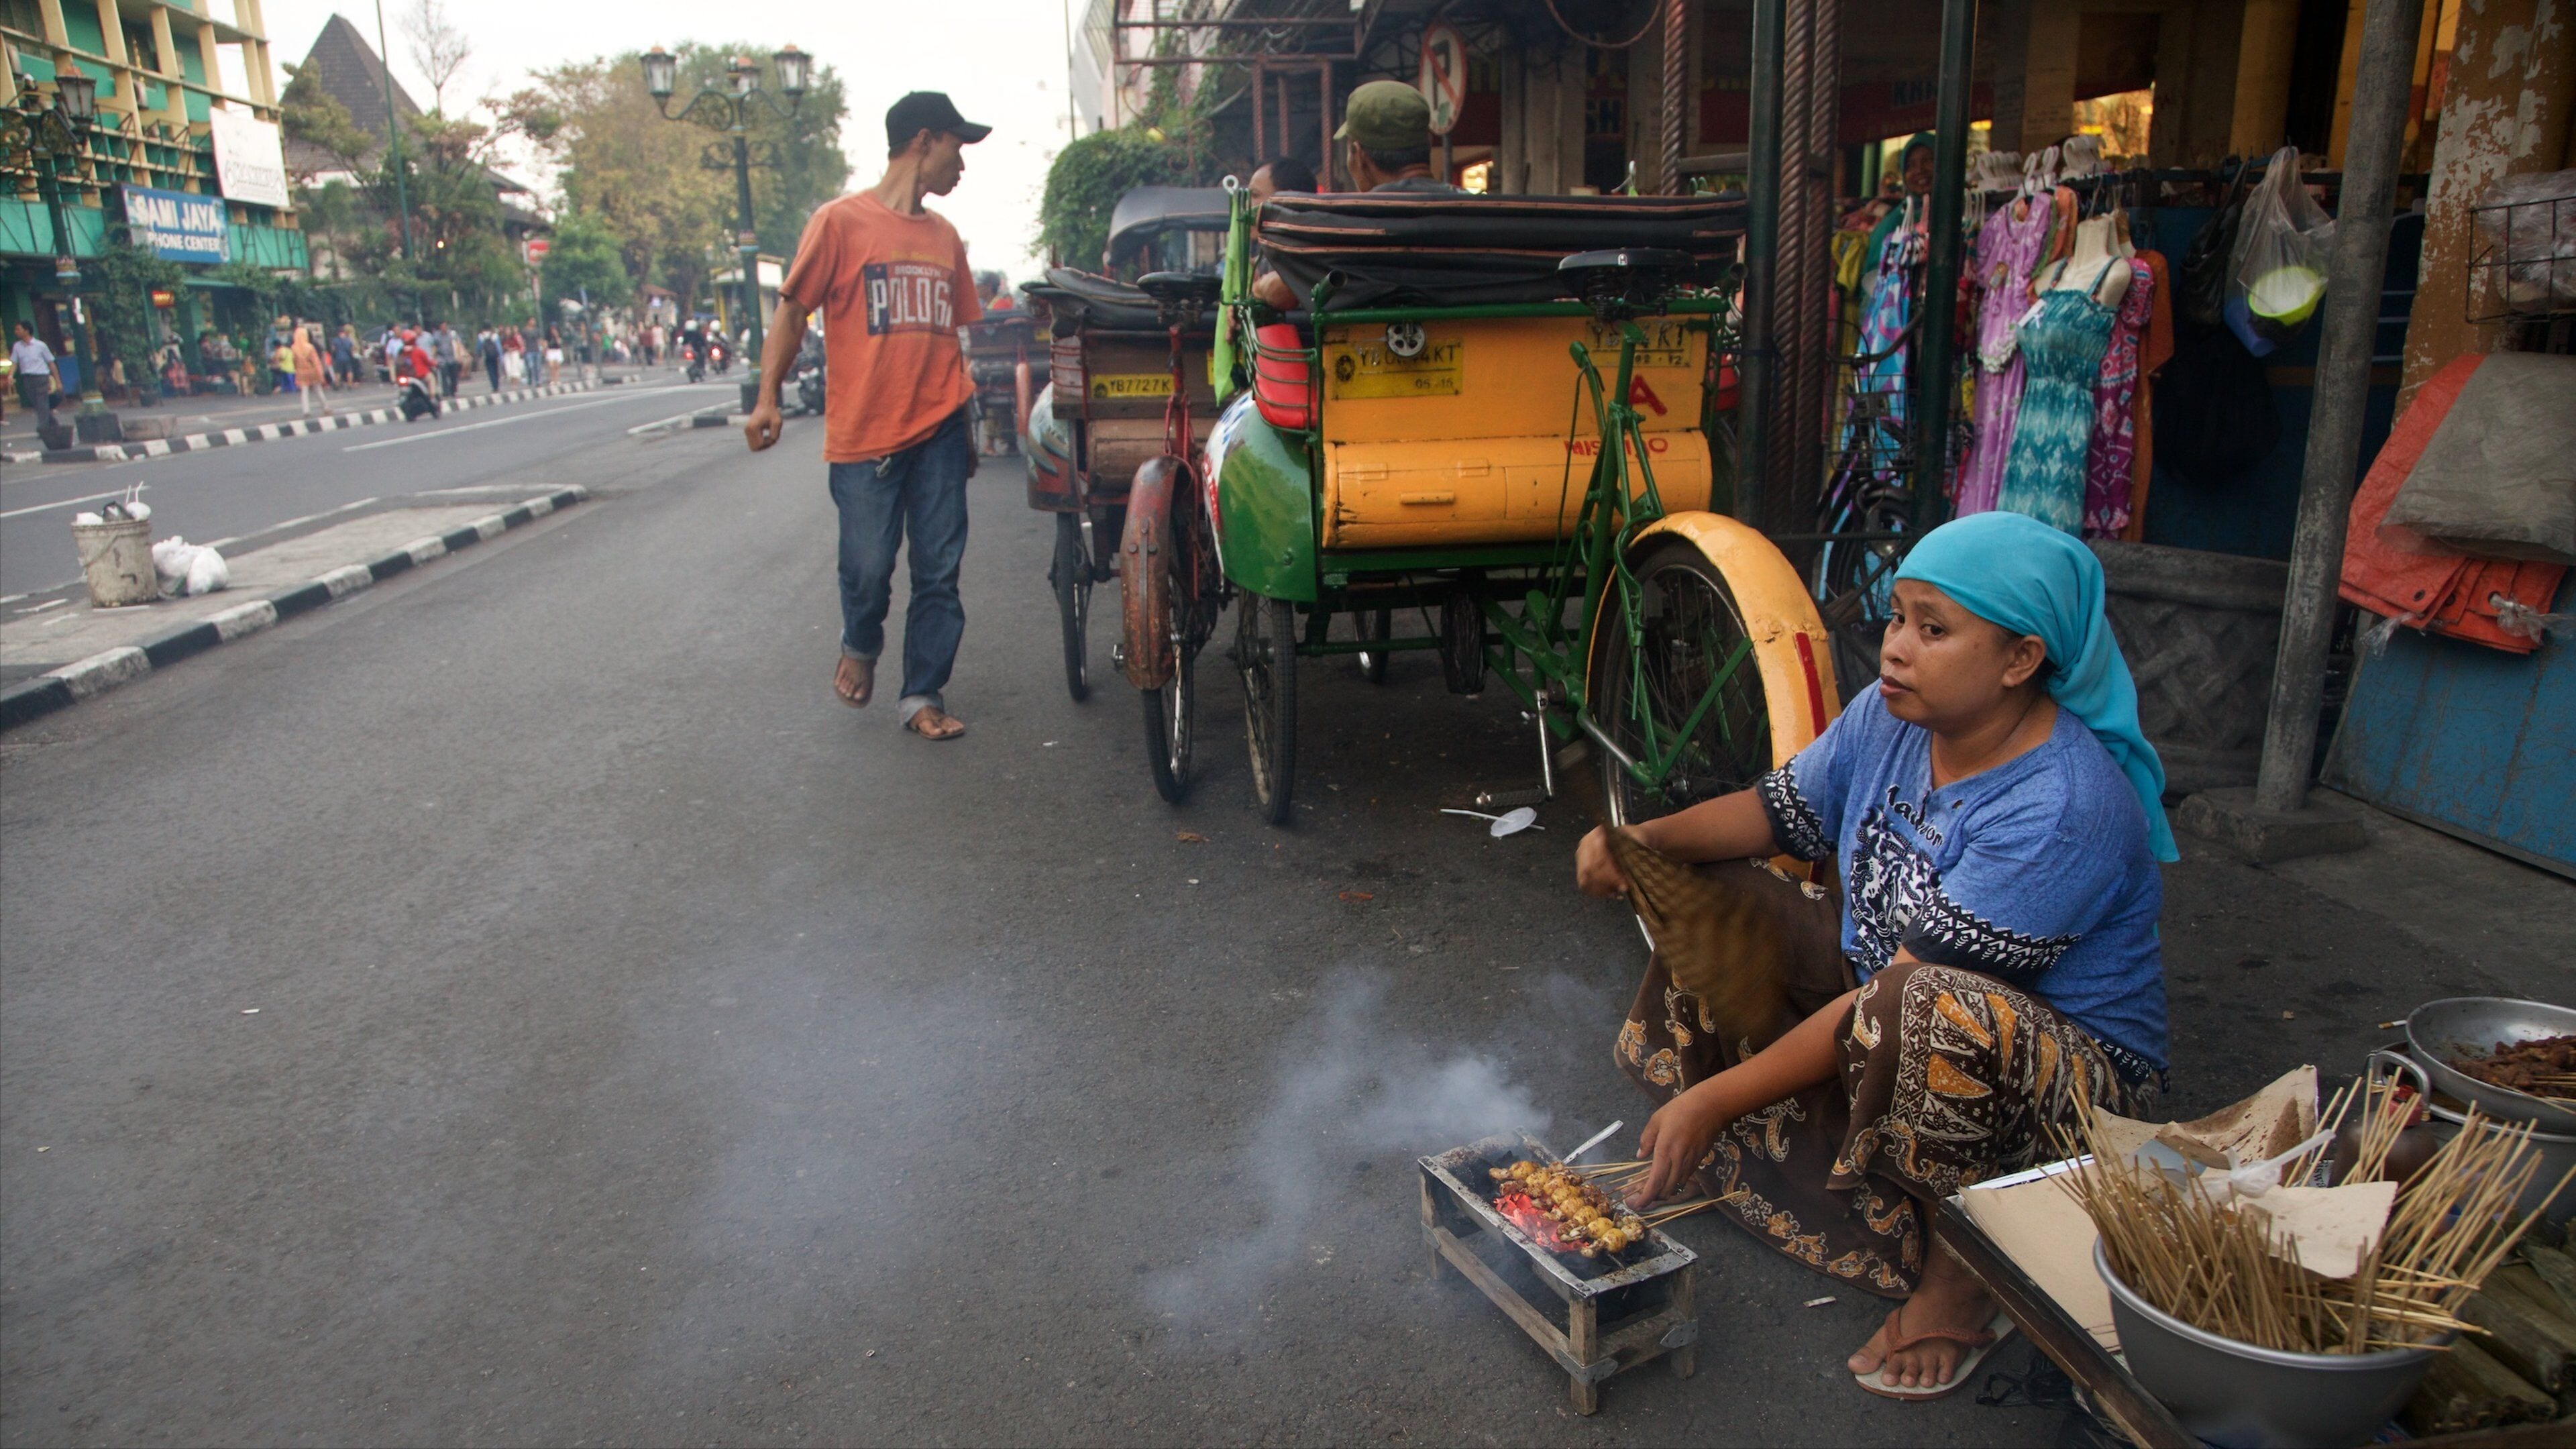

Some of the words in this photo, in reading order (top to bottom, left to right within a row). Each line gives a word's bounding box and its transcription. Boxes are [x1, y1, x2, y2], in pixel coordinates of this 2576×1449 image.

[134, 194, 180, 230] SAMI
[181, 202, 222, 234] JAYA
[147, 231, 184, 250] PHONE
[184, 235, 221, 253] CENTER
[894, 264, 941, 277] BROOKLYN
